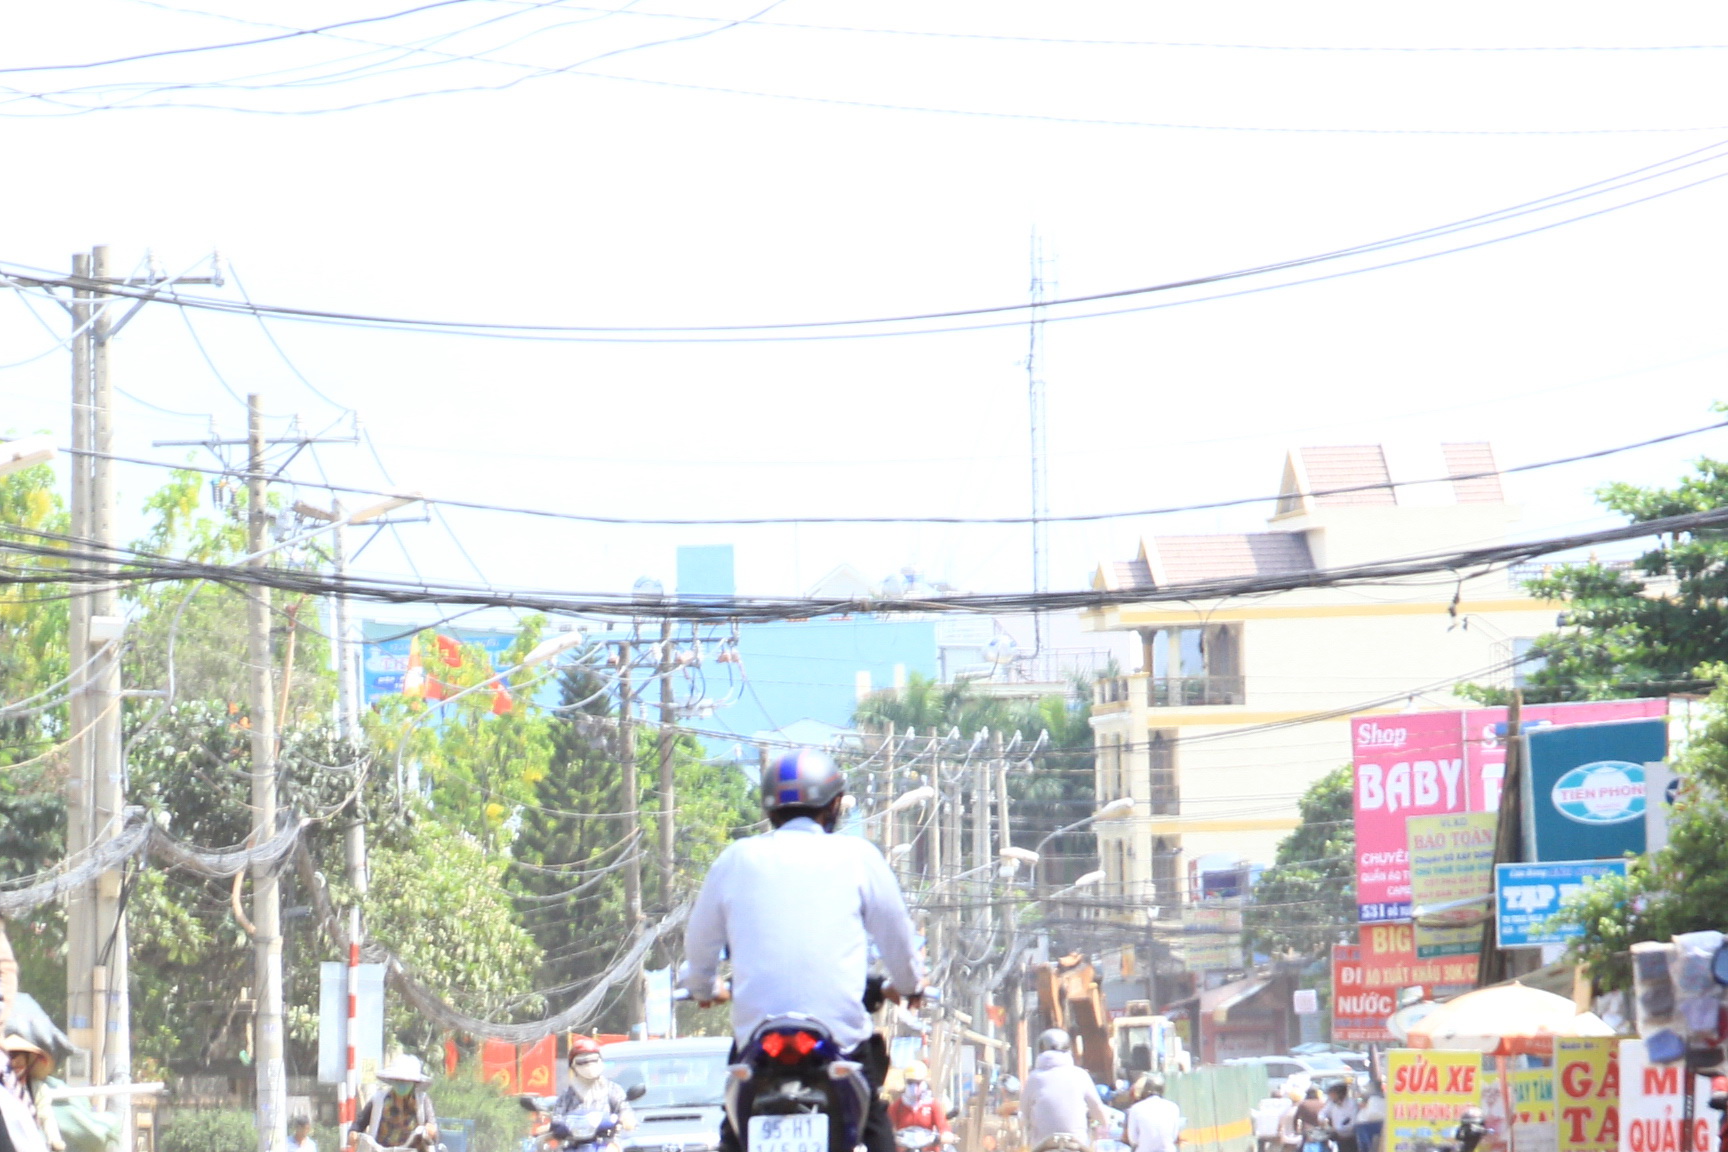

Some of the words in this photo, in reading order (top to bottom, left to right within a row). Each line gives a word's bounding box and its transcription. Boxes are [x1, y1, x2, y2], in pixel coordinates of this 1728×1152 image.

[1357, 722, 1408, 748] Shop
[1358, 759, 1462, 813] BABY
[1599, 784, 1645, 798] PHON
[1373, 926, 1412, 954] BIG
[1337, 991, 1393, 1014] NƯỚC
[1394, 1054, 1439, 1094] SỬA
[1446, 1065, 1476, 1093] XE
[1561, 1051, 1619, 1098] GÀ
[1643, 1067, 1679, 1096] M
